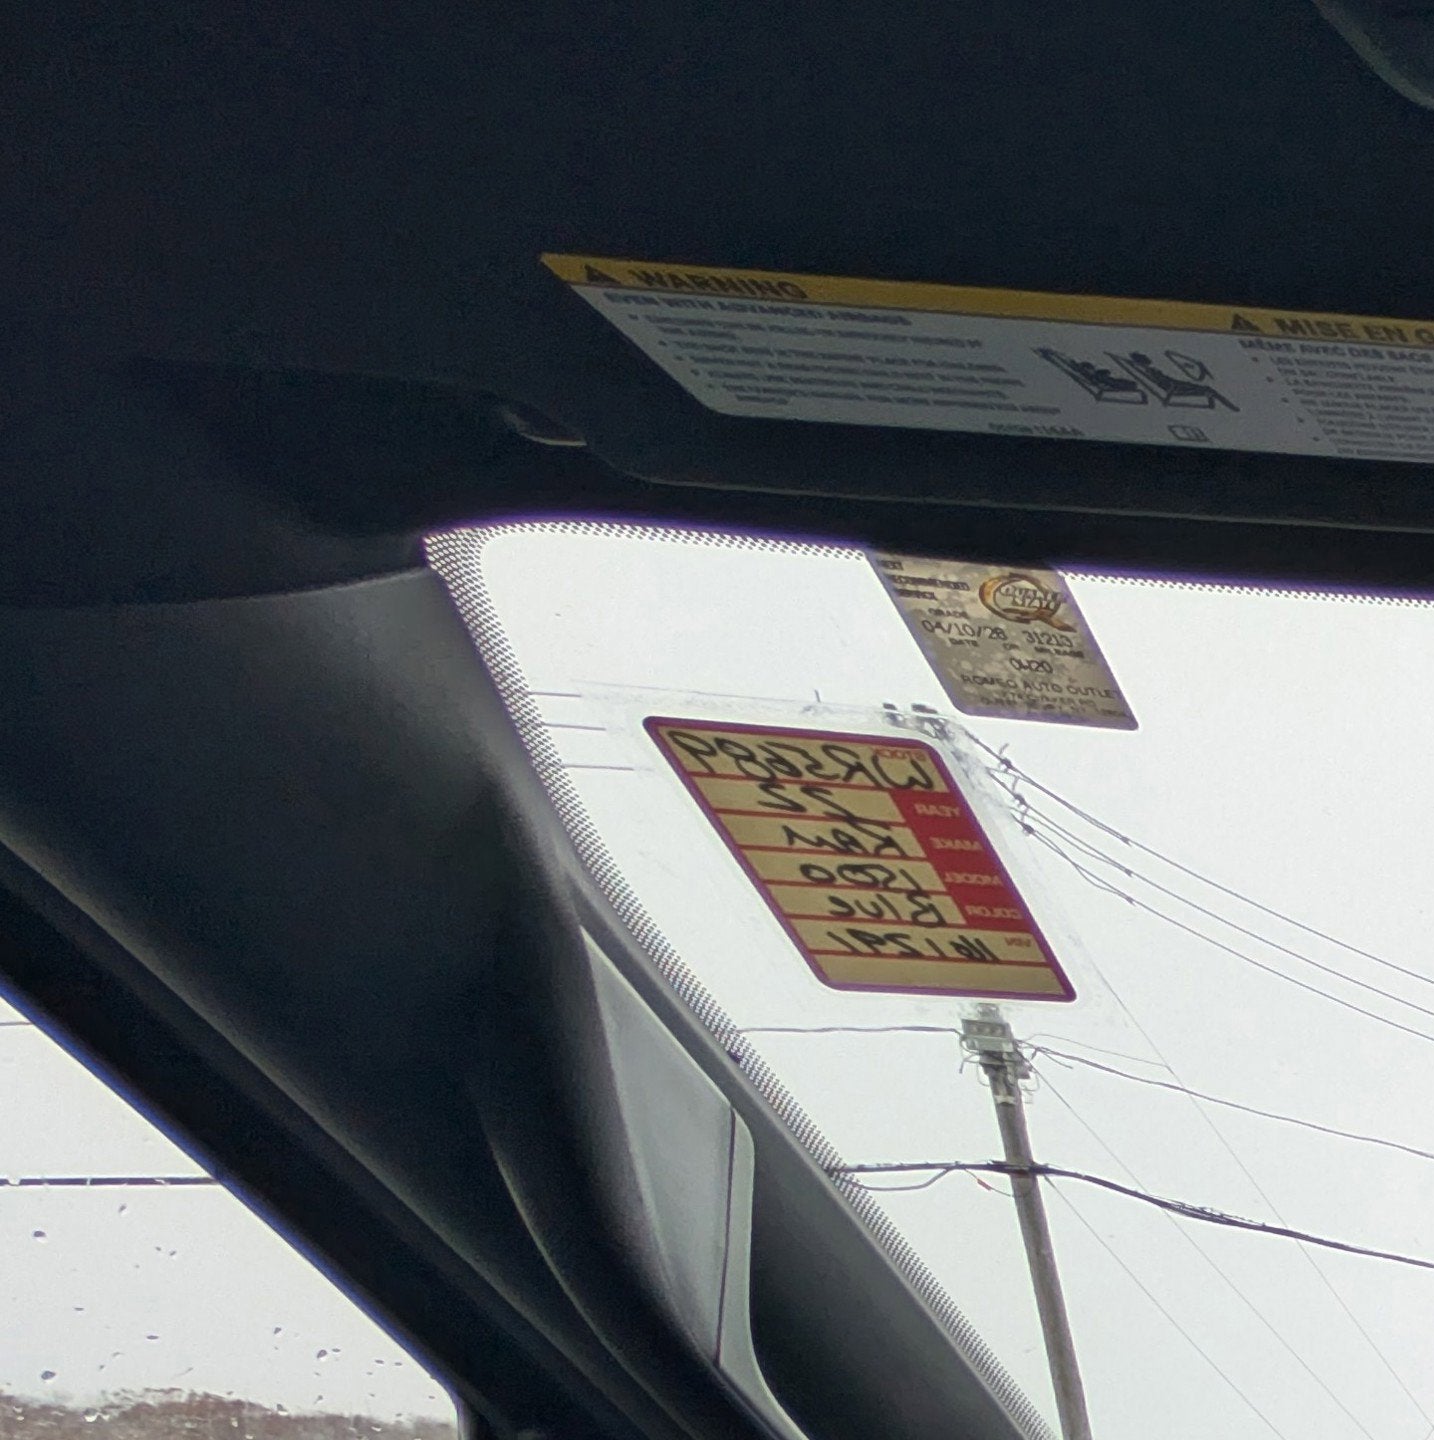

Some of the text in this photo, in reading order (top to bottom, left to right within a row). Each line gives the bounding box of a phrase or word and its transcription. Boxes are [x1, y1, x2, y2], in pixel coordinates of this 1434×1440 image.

[628, 269, 808, 299] WARNING
[1273, 318, 1357, 339] MISE
[1361, 324, 1409, 343] EN
[1023, 677, 1062, 693] AUTO
